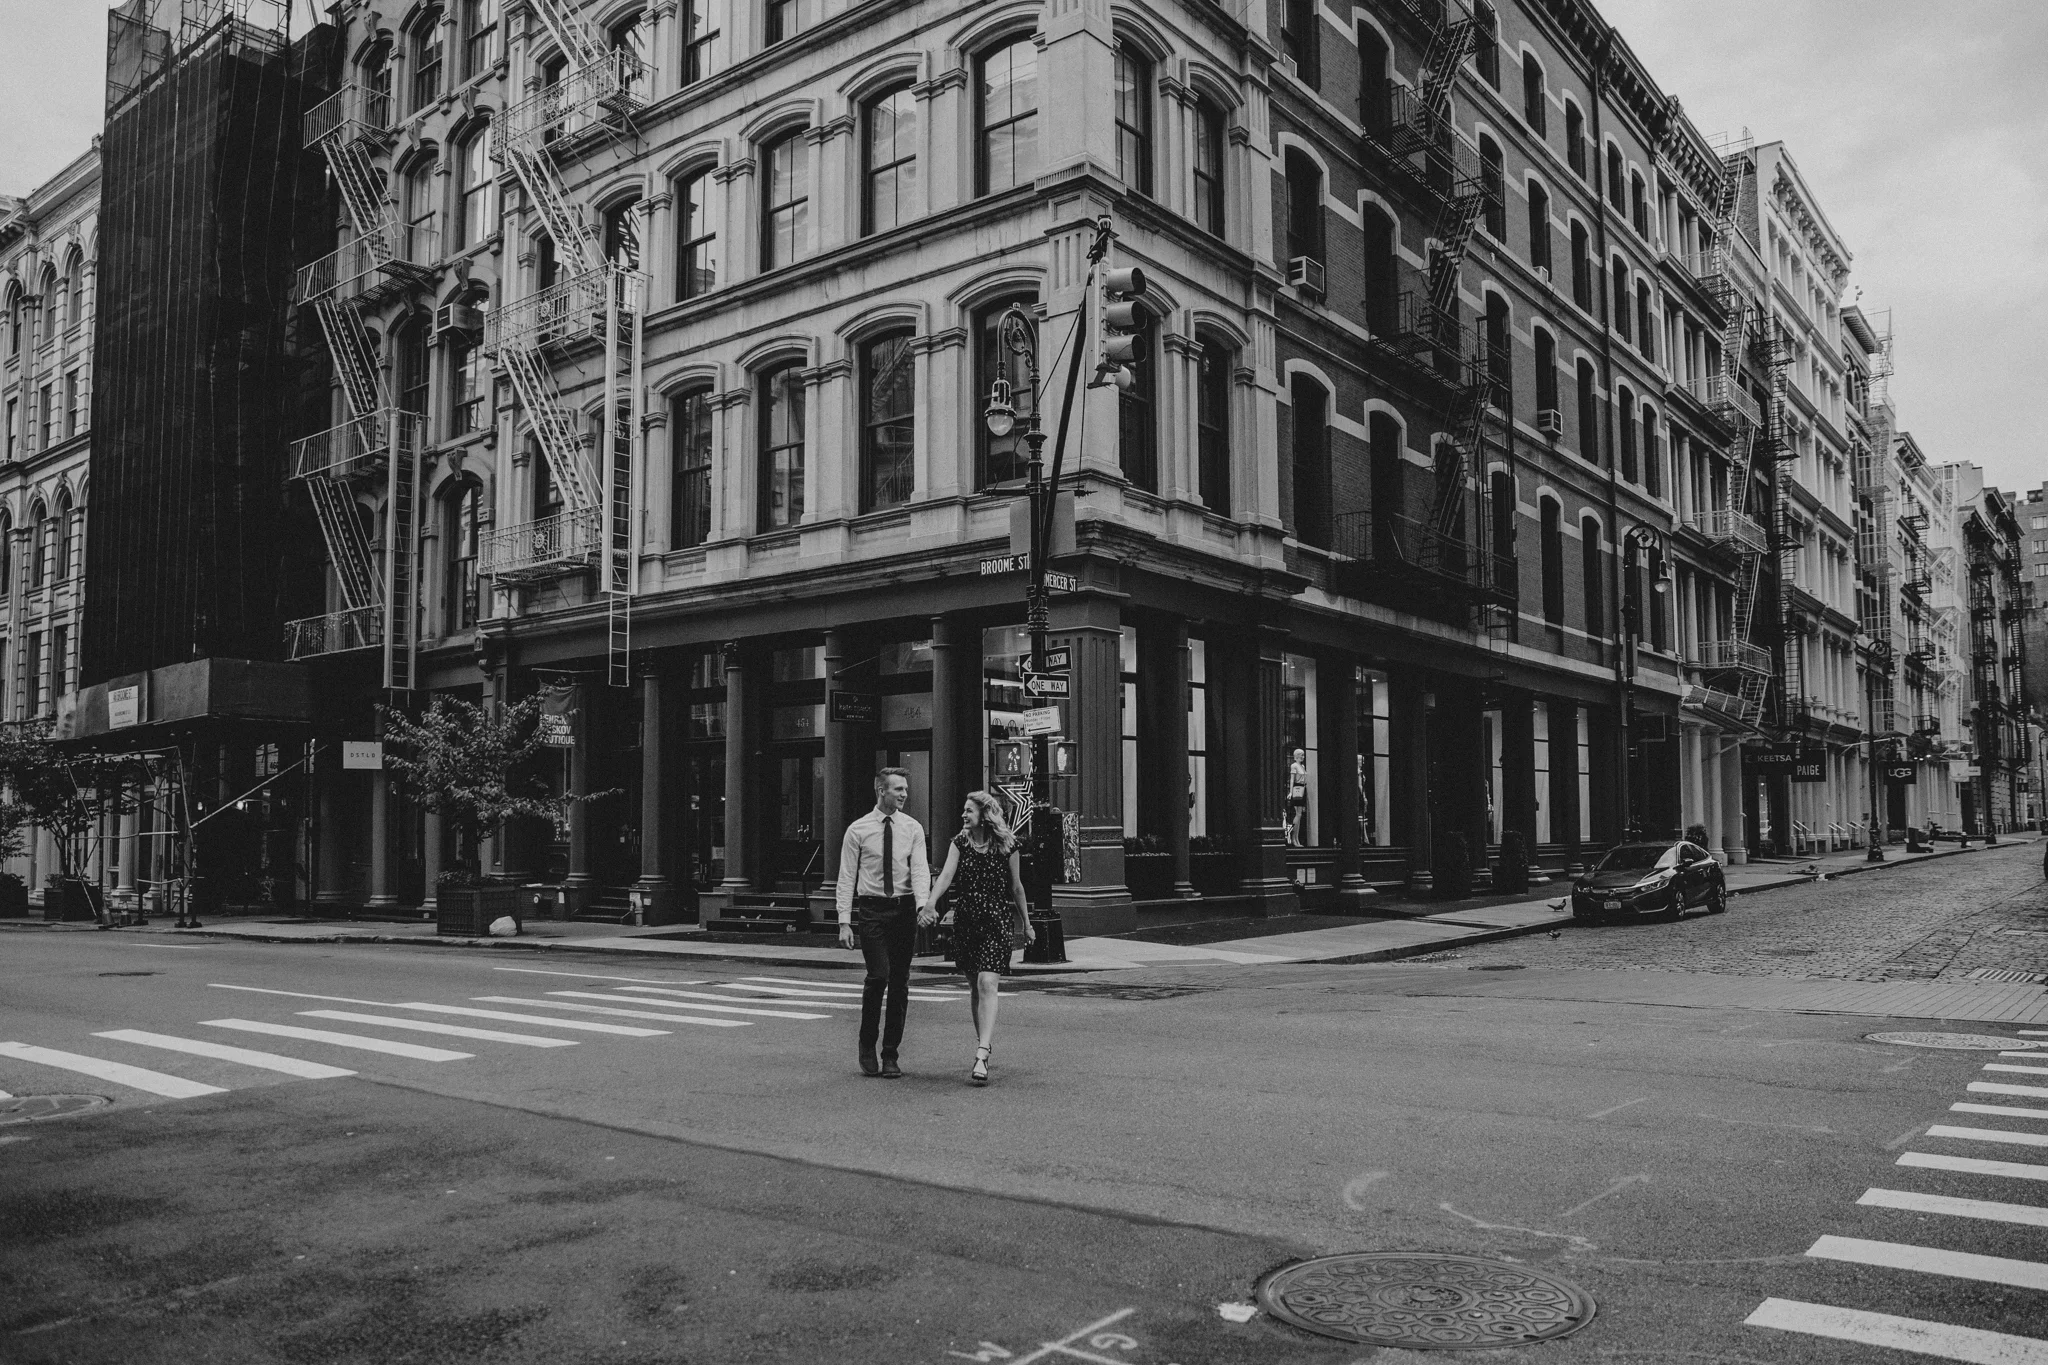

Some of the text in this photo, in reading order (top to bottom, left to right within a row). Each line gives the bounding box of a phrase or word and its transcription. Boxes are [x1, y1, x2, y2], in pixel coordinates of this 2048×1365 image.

[981, 555, 1028, 575] BROOME ST
[1045, 573, 1077, 592] MERCER ST
[1031, 680, 1064, 691] ONE WAY
[547, 724, 572, 735] SKOV
[543, 734, 576, 745] UTIQUE
[1757, 754, 1792, 762] KEETSA
[1796, 764, 1820, 776] PAIGE
[1888, 767, 1912, 778] UGG
